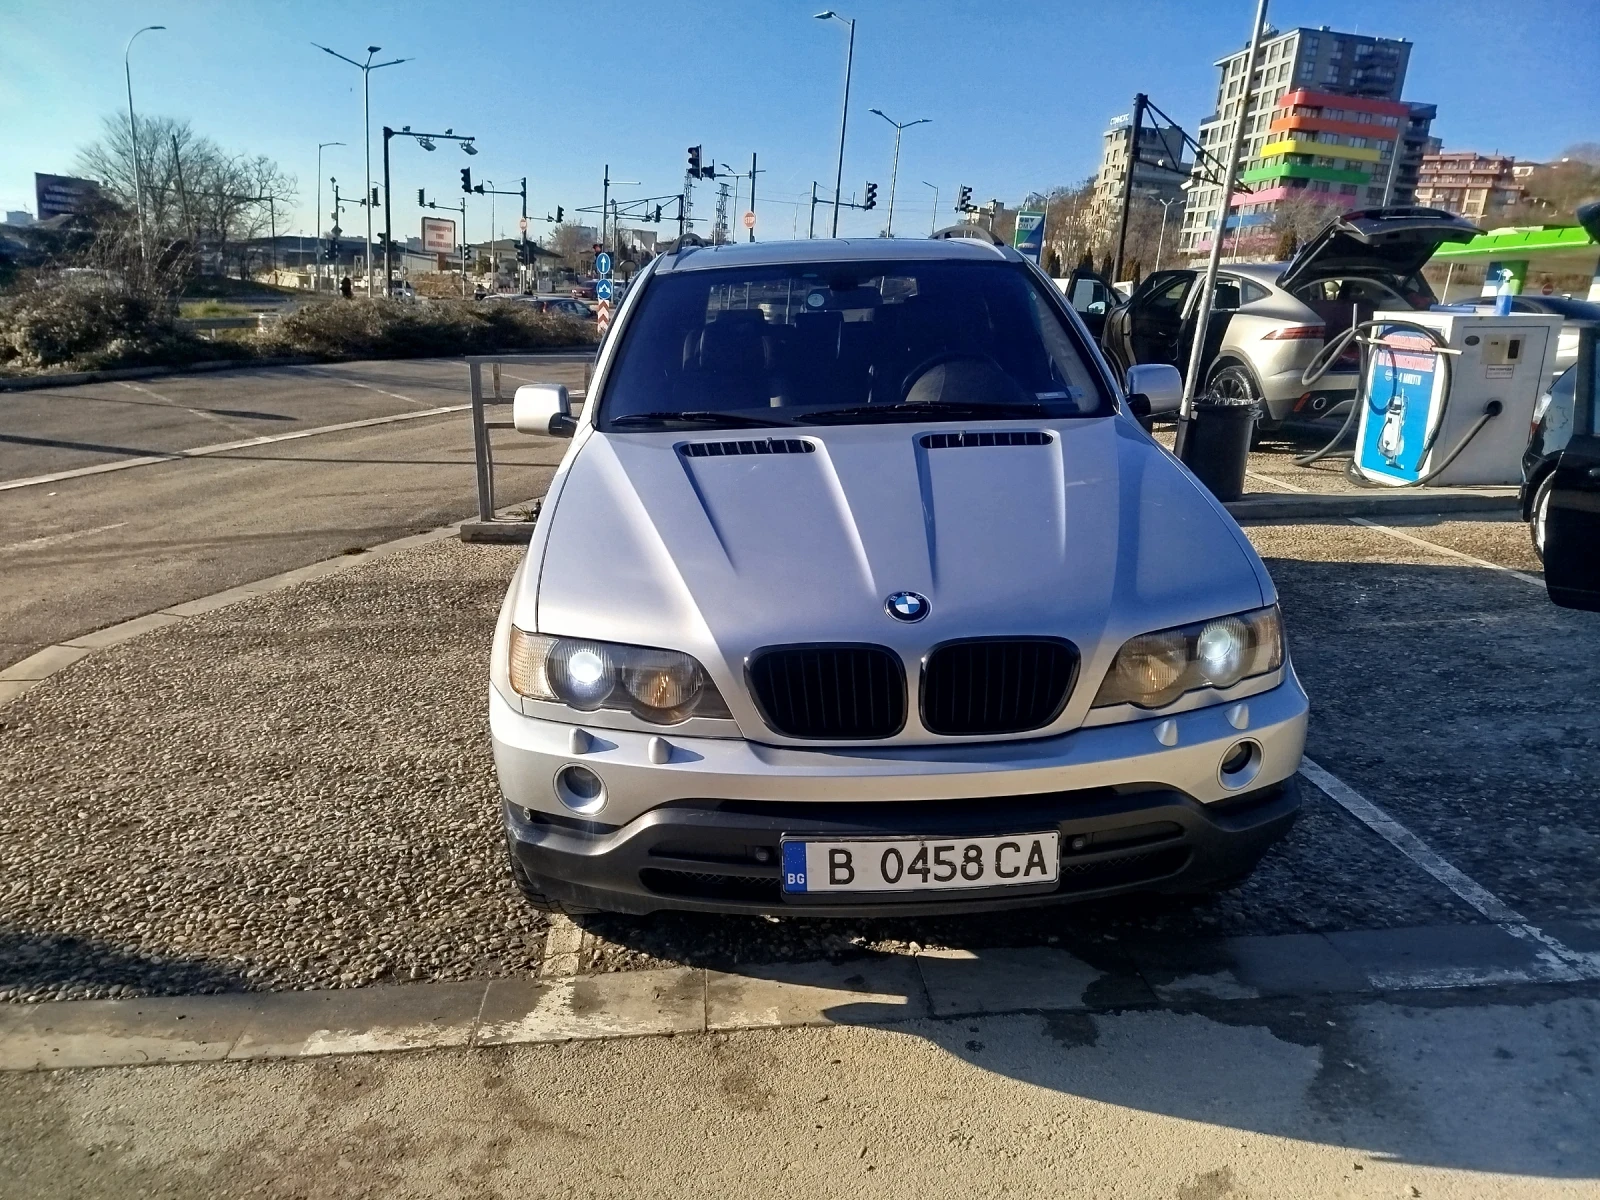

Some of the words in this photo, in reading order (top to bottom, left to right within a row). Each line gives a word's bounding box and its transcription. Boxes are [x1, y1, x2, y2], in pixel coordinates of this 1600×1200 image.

[890, 592, 923, 602] BMW
[828, 848, 855, 885] B
[880, 844, 984, 884] 0458
[994, 840, 1048, 879] CA
[787, 873, 805, 885] BG
